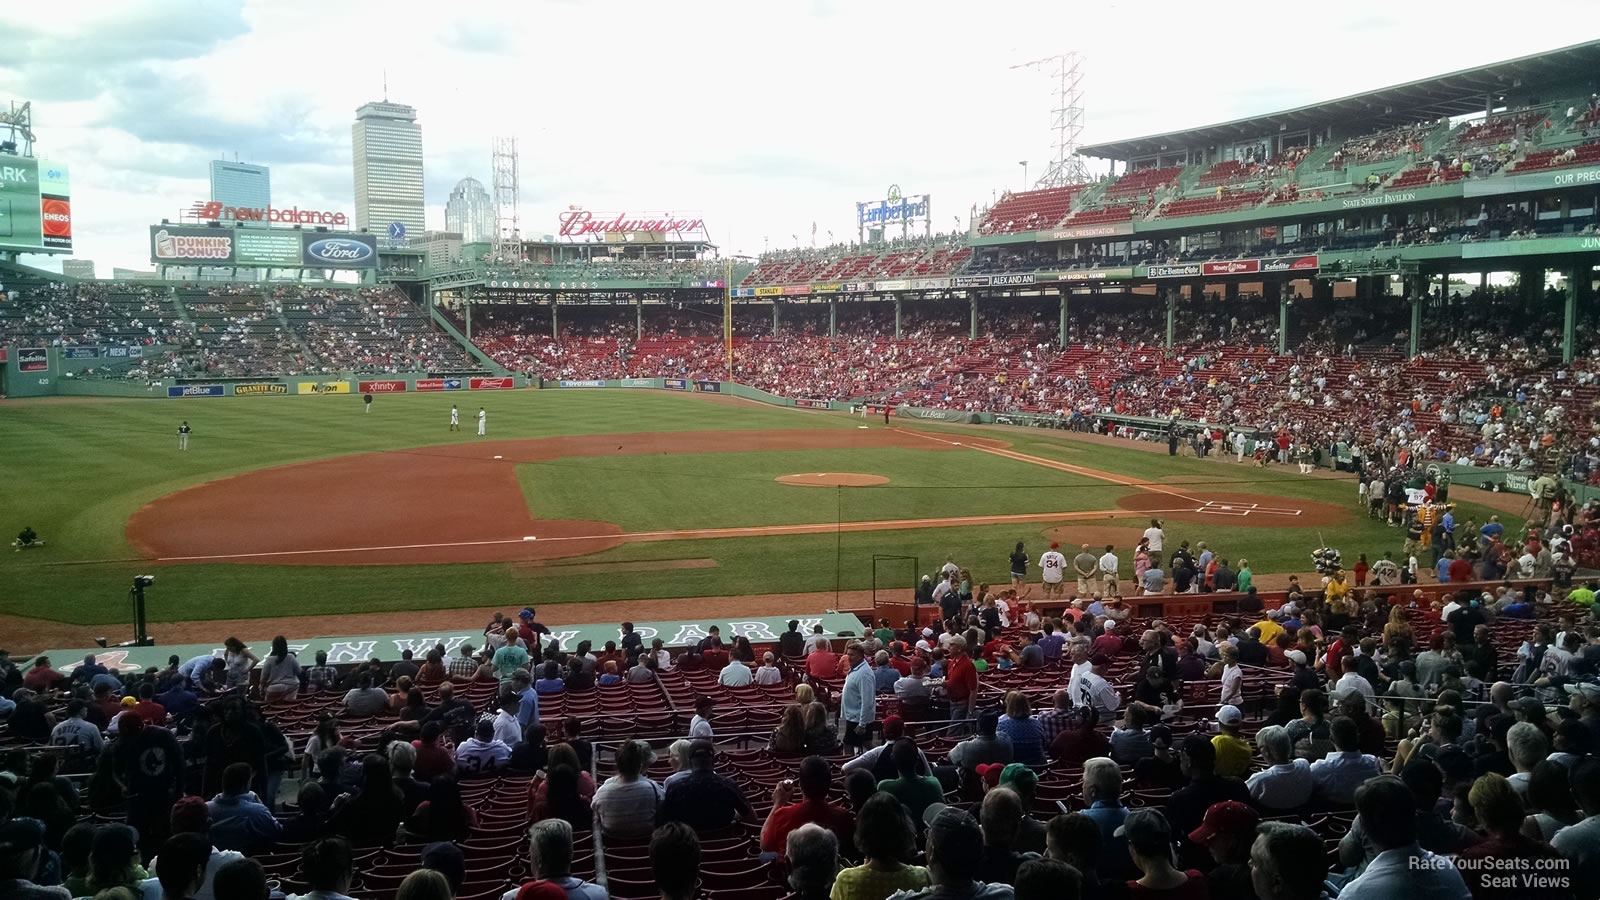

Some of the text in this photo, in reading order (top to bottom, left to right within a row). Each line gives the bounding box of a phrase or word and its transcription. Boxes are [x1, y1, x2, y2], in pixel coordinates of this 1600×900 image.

[1554, 174, 1574, 185] OUR
[1342, 192, 1416, 208] STATE STREET PAVILION
[224, 206, 265, 222] new
[267, 205, 346, 225] balance
[860, 196, 927, 223] Cumberland
[43, 212, 70, 222] ENEOS
[559, 211, 702, 236] Budweiser
[1053, 227, 1115, 239] SPECIAL PRESENTATION
[177, 237, 230, 248] DUNKIN'
[1581, 237, 1600, 248] JUN
[177, 247, 228, 257] DONUTS
[321, 243, 361, 259] Ford
[1264, 262, 1290, 271] Safelite
[993, 276, 1008, 284] ALEX
[1008, 275, 1022, 283] AND
[109, 348, 127, 356] NESN
[182, 386, 210, 396] jetBlue
[236, 384, 287, 394] GRANITE CITY
[369, 381, 396, 392] xfinity
[1506, 473, 1528, 482] Ninety
[1506, 480, 1527, 490] Nine
[1046, 560, 1058, 568] 34
[1380, 568, 1394, 576] 47
[1080, 688, 1092, 706] 79
[1192, 691, 1206, 699] 60
[57, 724, 81, 735] ORTIZ
[466, 756, 497, 772] 34
